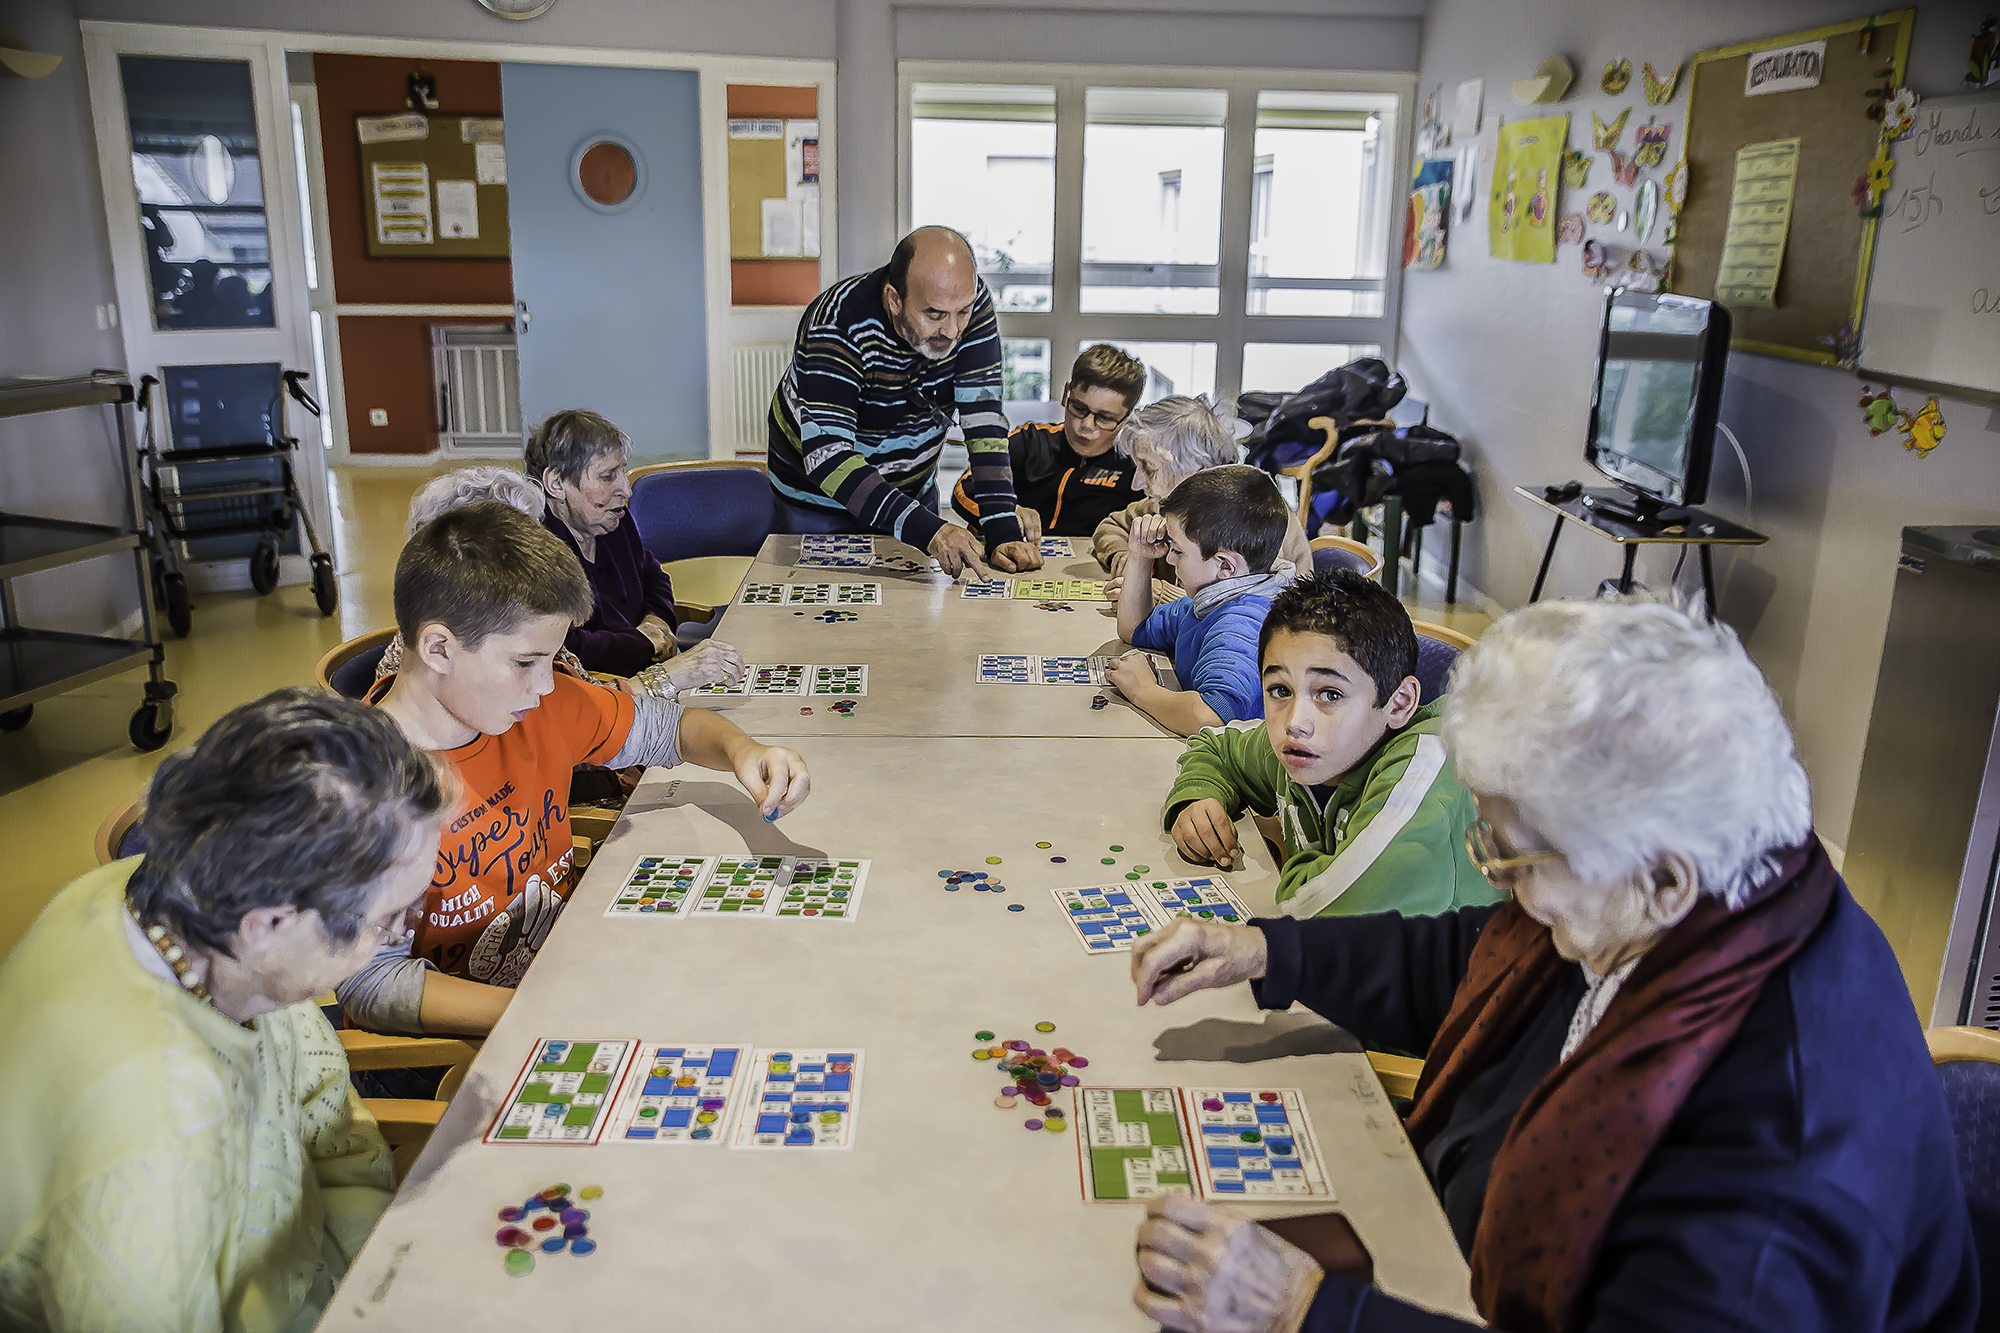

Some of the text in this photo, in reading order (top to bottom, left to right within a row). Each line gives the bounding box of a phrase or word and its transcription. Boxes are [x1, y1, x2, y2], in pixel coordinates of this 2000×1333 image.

[1914, 106, 1984, 157] Mardi
[449, 780, 516, 834] CUSTOM MADE
[483, 789, 567, 896] Tough
[429, 895, 497, 928] QUALITY
[440, 884, 482, 913] HIGH
